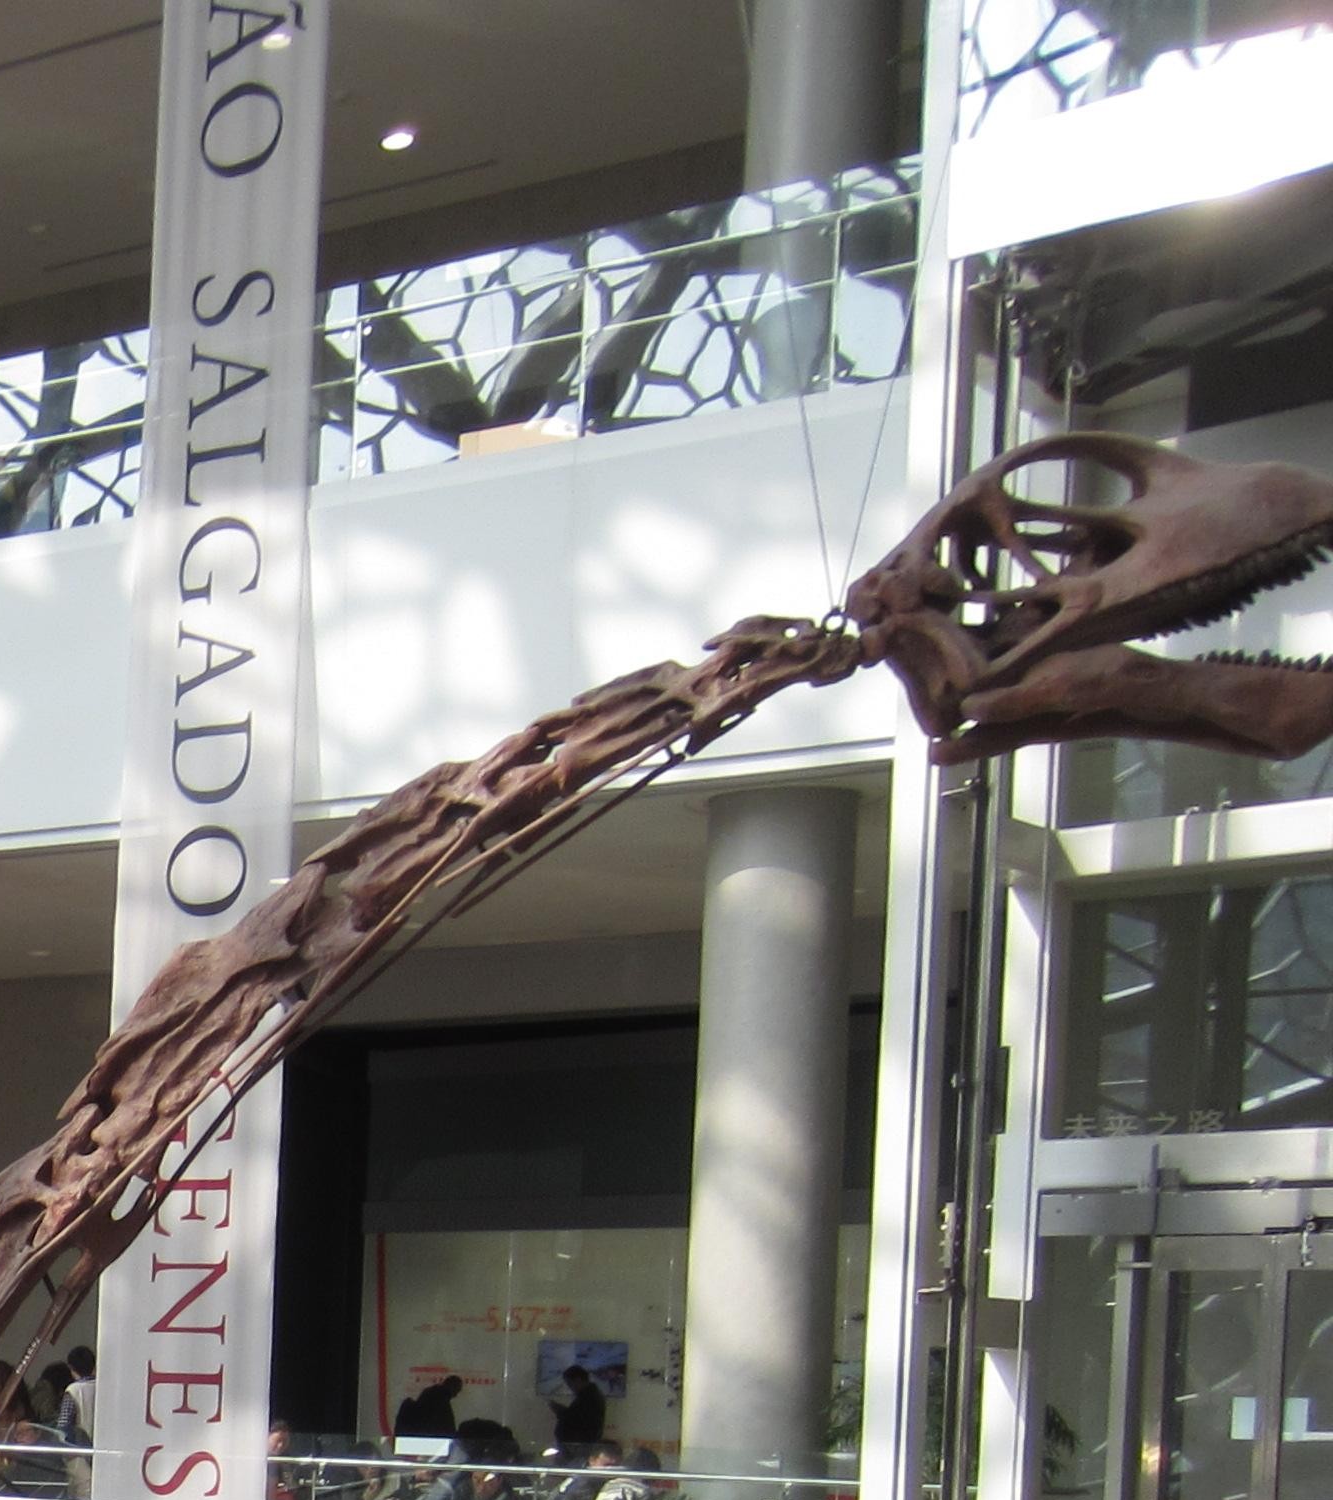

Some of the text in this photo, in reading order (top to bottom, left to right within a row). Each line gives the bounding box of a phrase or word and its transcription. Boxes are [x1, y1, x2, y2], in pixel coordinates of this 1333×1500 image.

[166, 269, 275, 917] SALGADO
[1062, 1110, 1226, 1138] 未来之路
